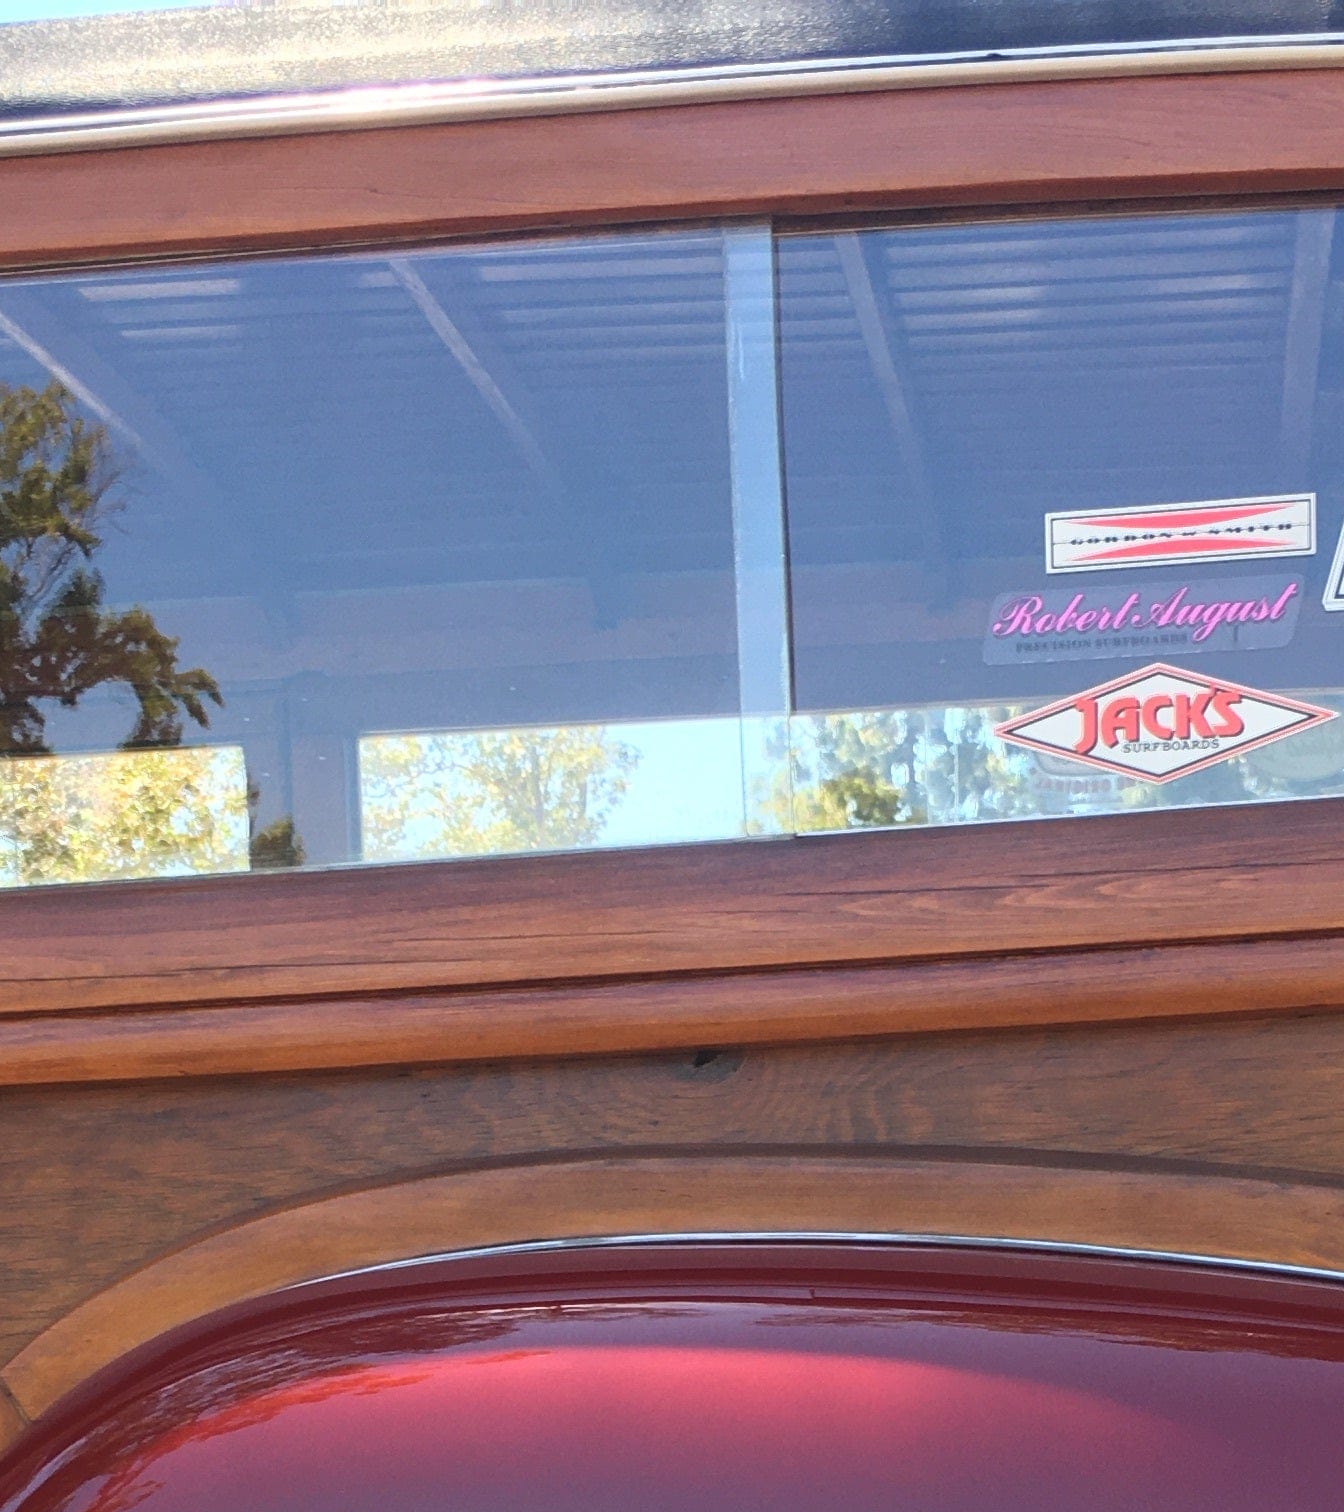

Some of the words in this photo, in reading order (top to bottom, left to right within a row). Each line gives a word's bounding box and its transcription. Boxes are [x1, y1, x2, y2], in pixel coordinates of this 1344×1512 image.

[992, 592, 1140, 638] Robert
[1131, 581, 1299, 643] August
[1122, 738, 1221, 755] SURFBOARDS
